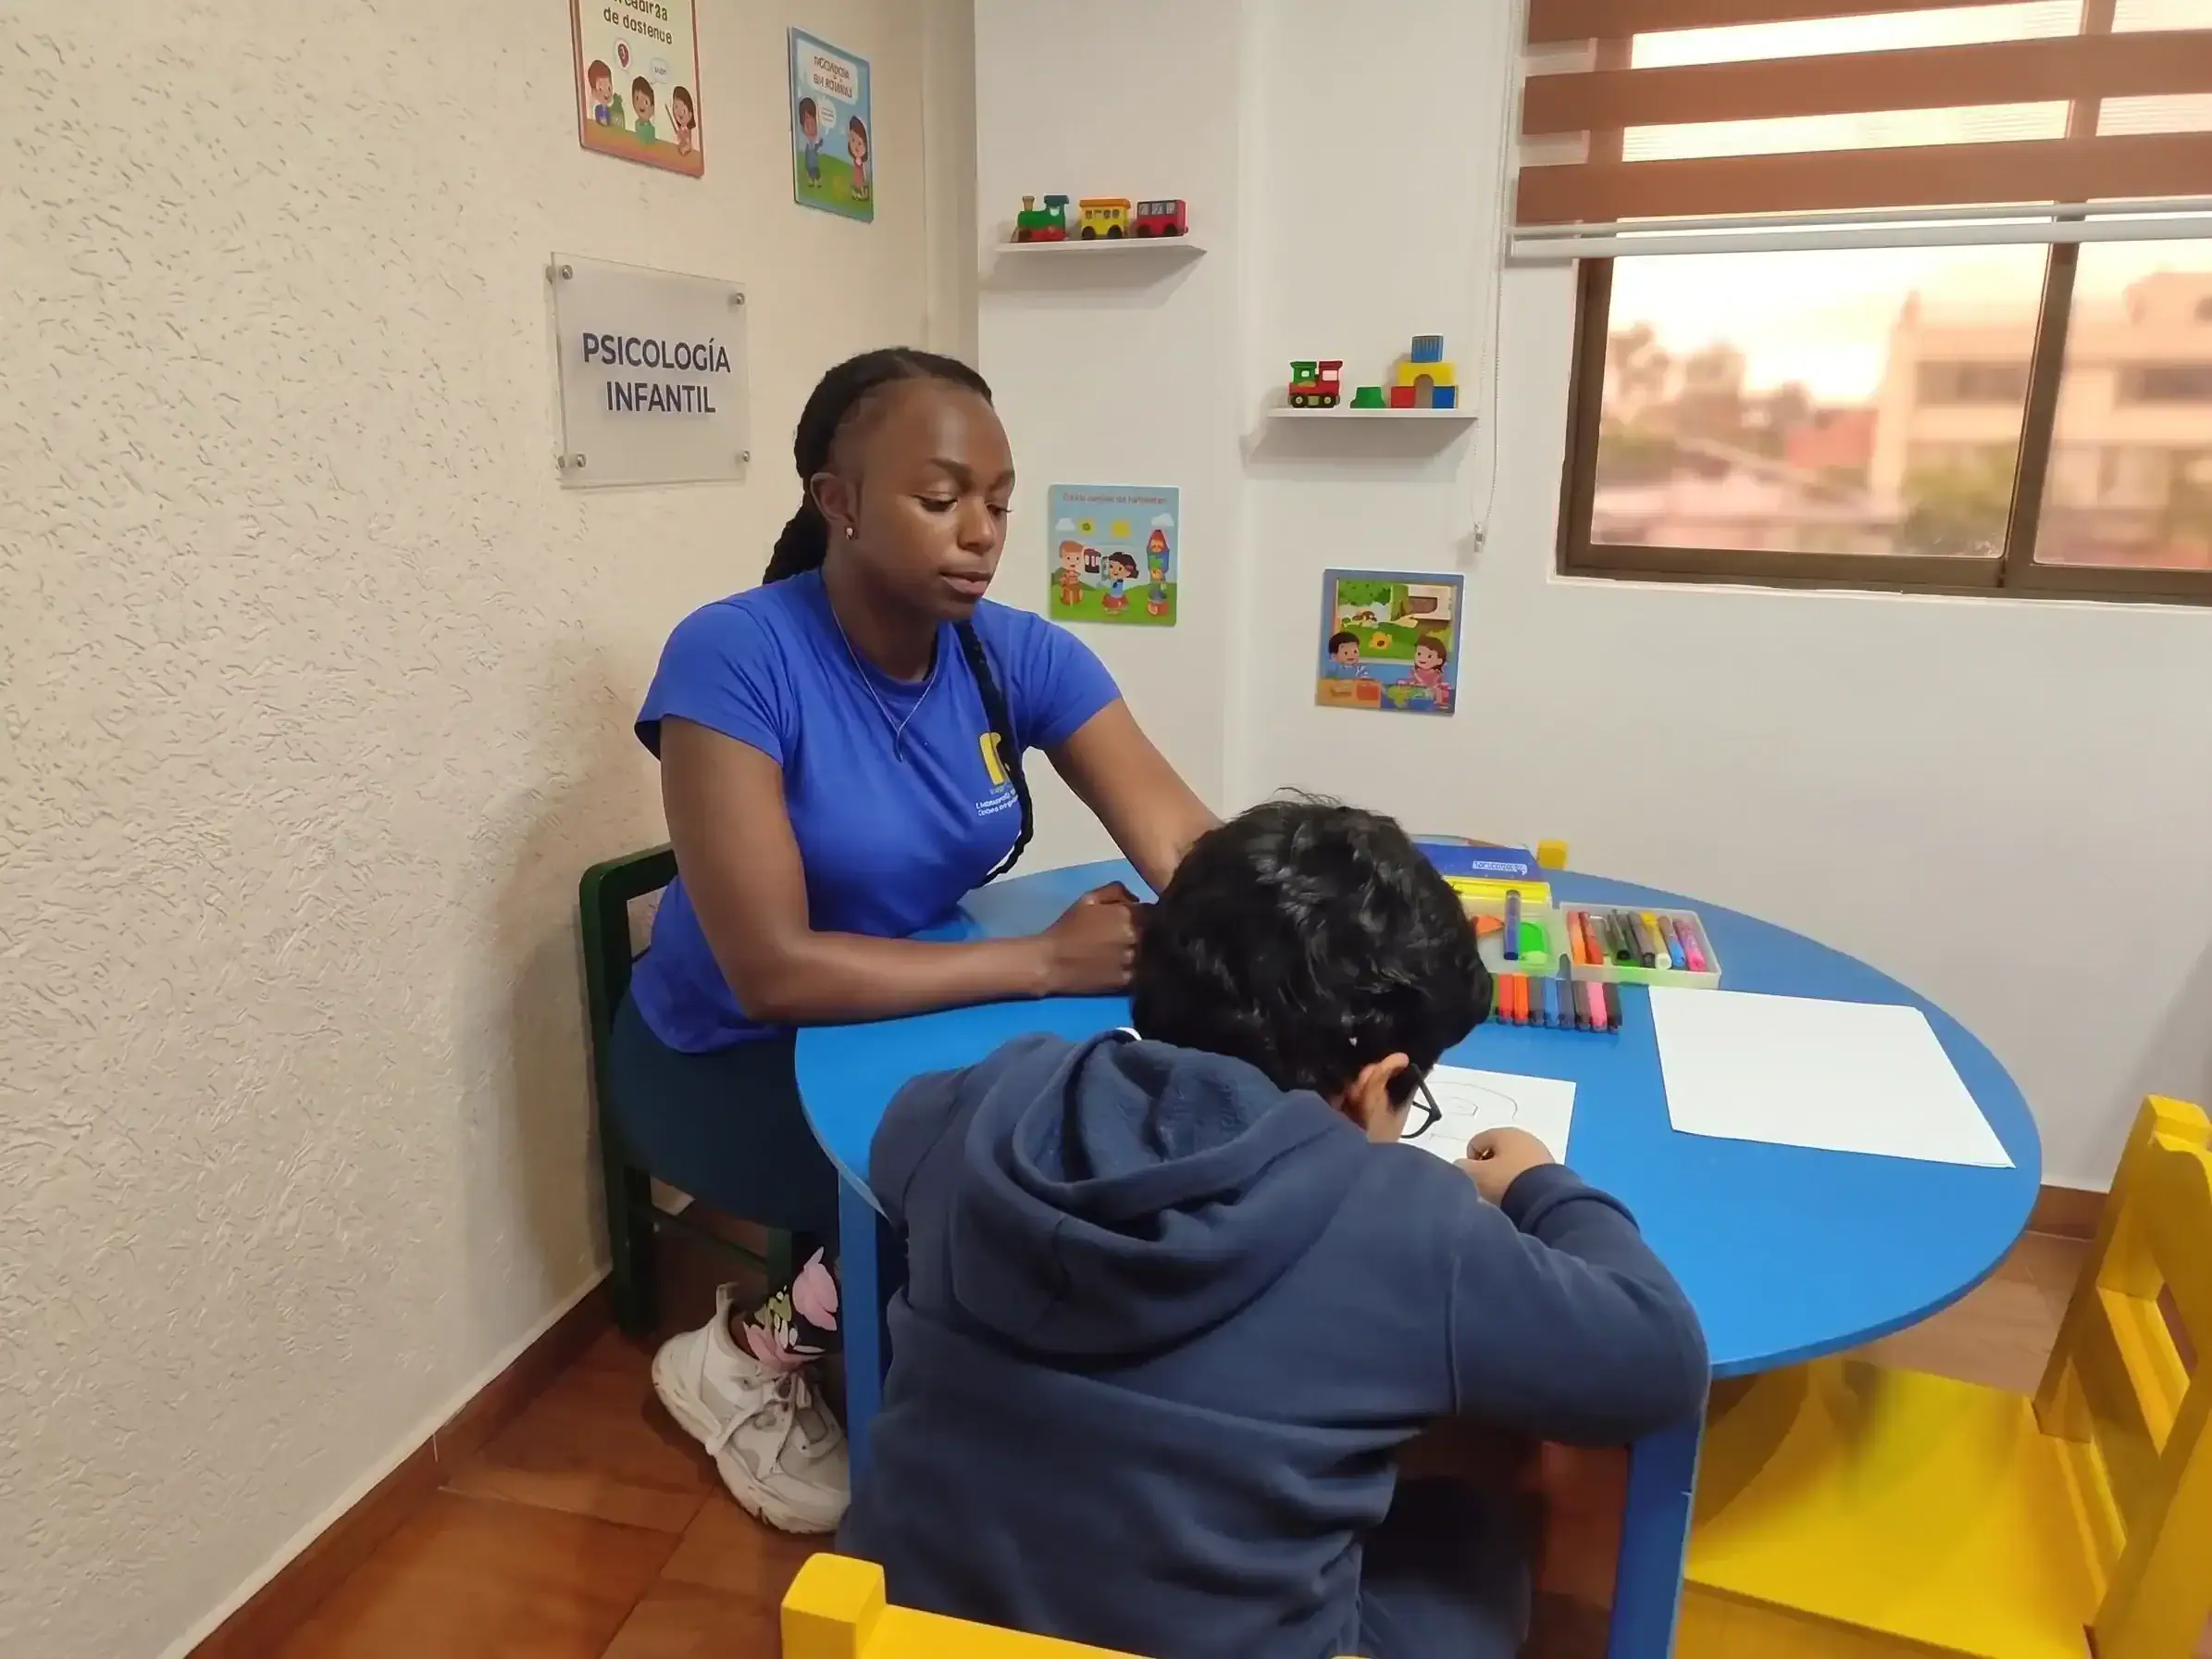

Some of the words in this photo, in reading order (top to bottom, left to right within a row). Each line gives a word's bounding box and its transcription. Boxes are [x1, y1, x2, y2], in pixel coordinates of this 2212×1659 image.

[603, 7, 619, 25] de
[582, 332, 731, 373] PSICOLOGÍA
[606, 380, 716, 414] INFANTIL
